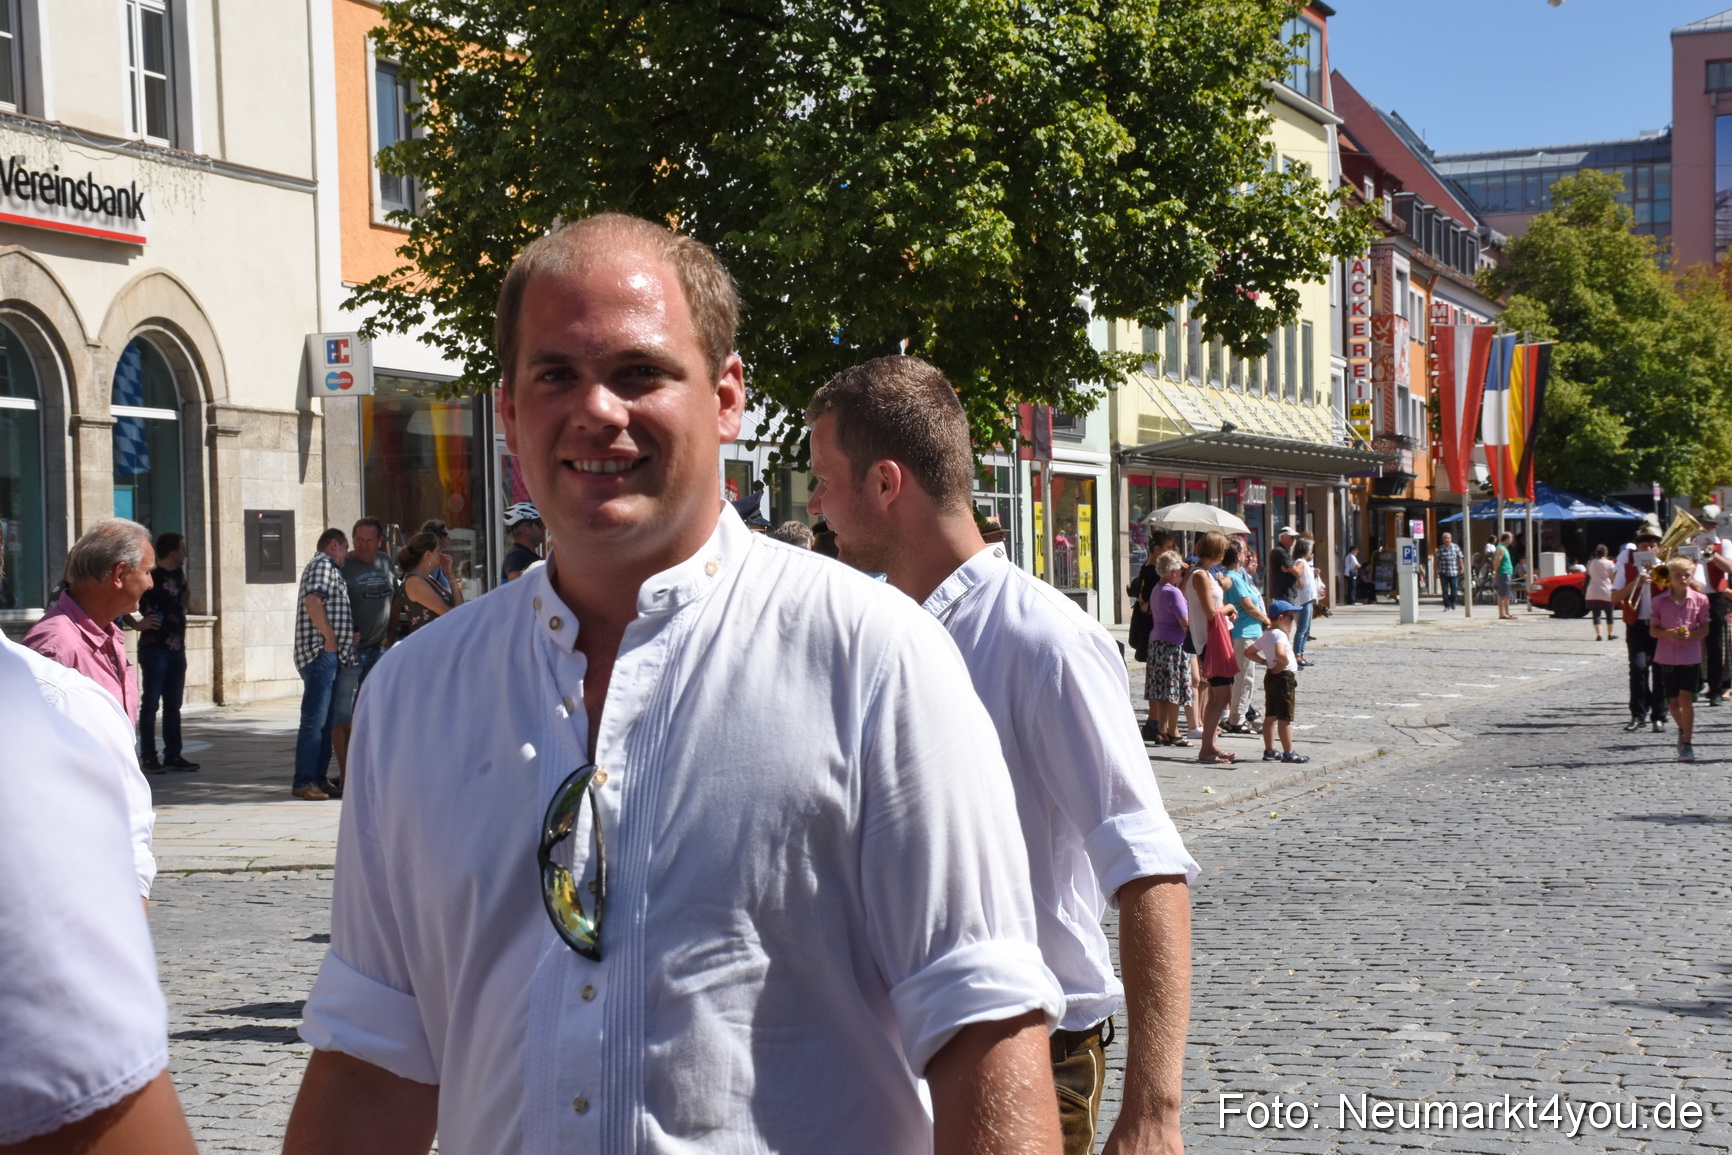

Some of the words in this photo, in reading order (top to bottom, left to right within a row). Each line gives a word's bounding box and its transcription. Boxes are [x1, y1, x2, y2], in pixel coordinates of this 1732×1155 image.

[0, 155, 146, 222] Vereinsbank
[1350, 258, 1367, 398] ÄCKEREI
[1350, 407, 1370, 417] café
[1404, 547, 1411, 558] P
